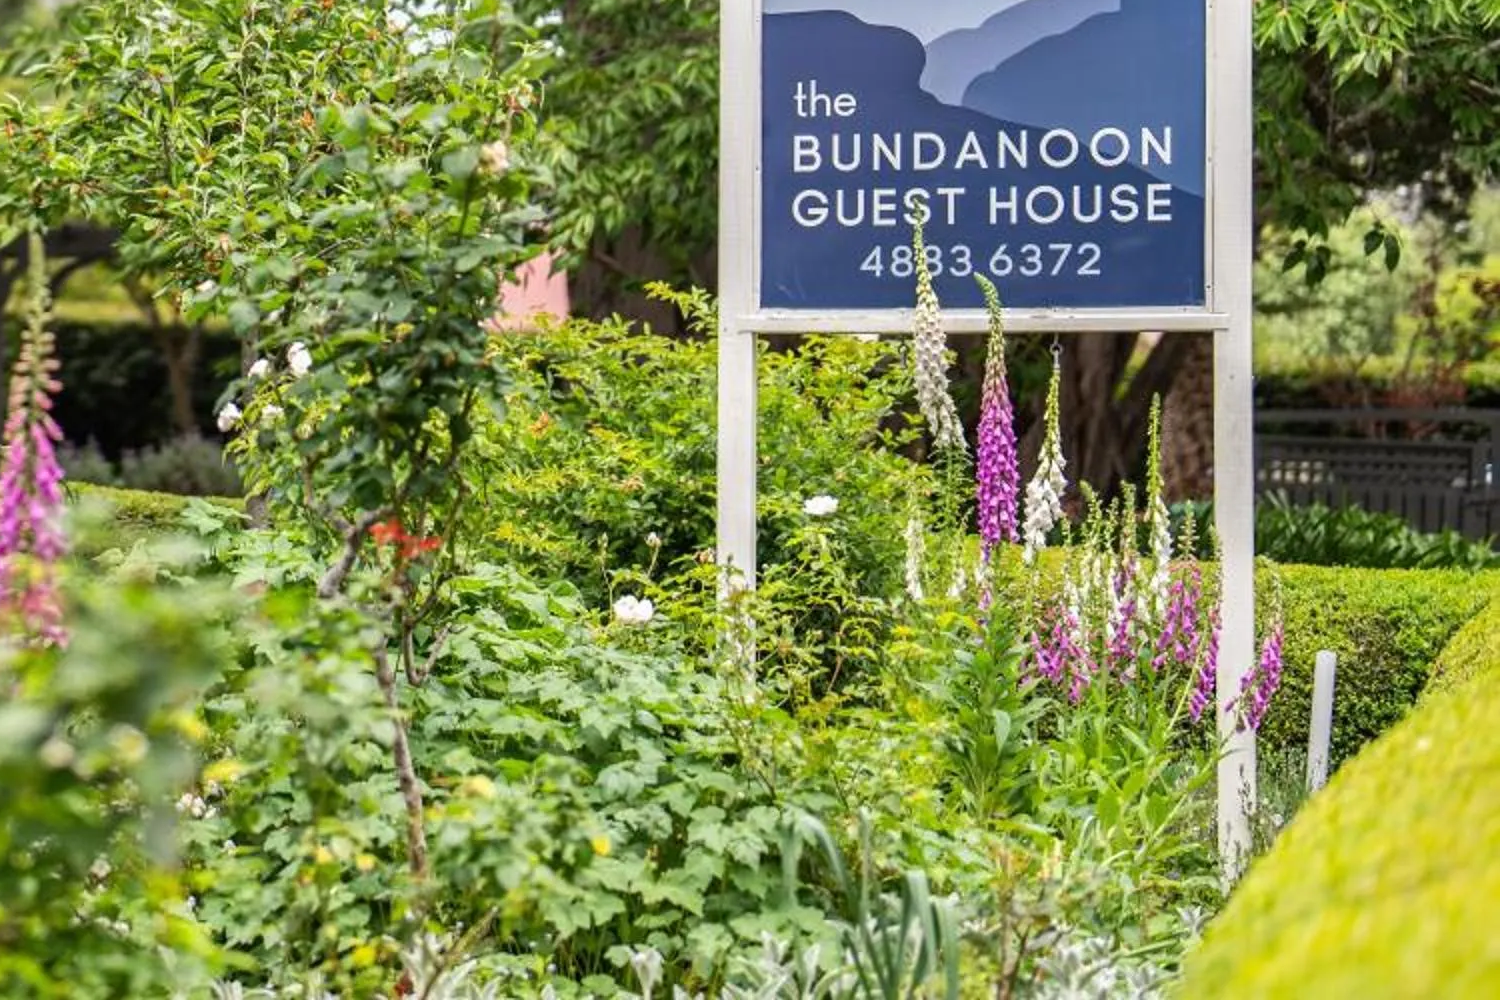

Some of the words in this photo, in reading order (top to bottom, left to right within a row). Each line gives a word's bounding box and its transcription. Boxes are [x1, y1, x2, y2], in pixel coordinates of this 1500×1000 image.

[793, 80, 857, 117] the
[792, 127, 1173, 172] BUNDANOON
[791, 187, 966, 227] GUEST
[989, 183, 1173, 226] HOUSE
[860, 244, 973, 278] 4883
[988, 243, 1102, 277] 6372
